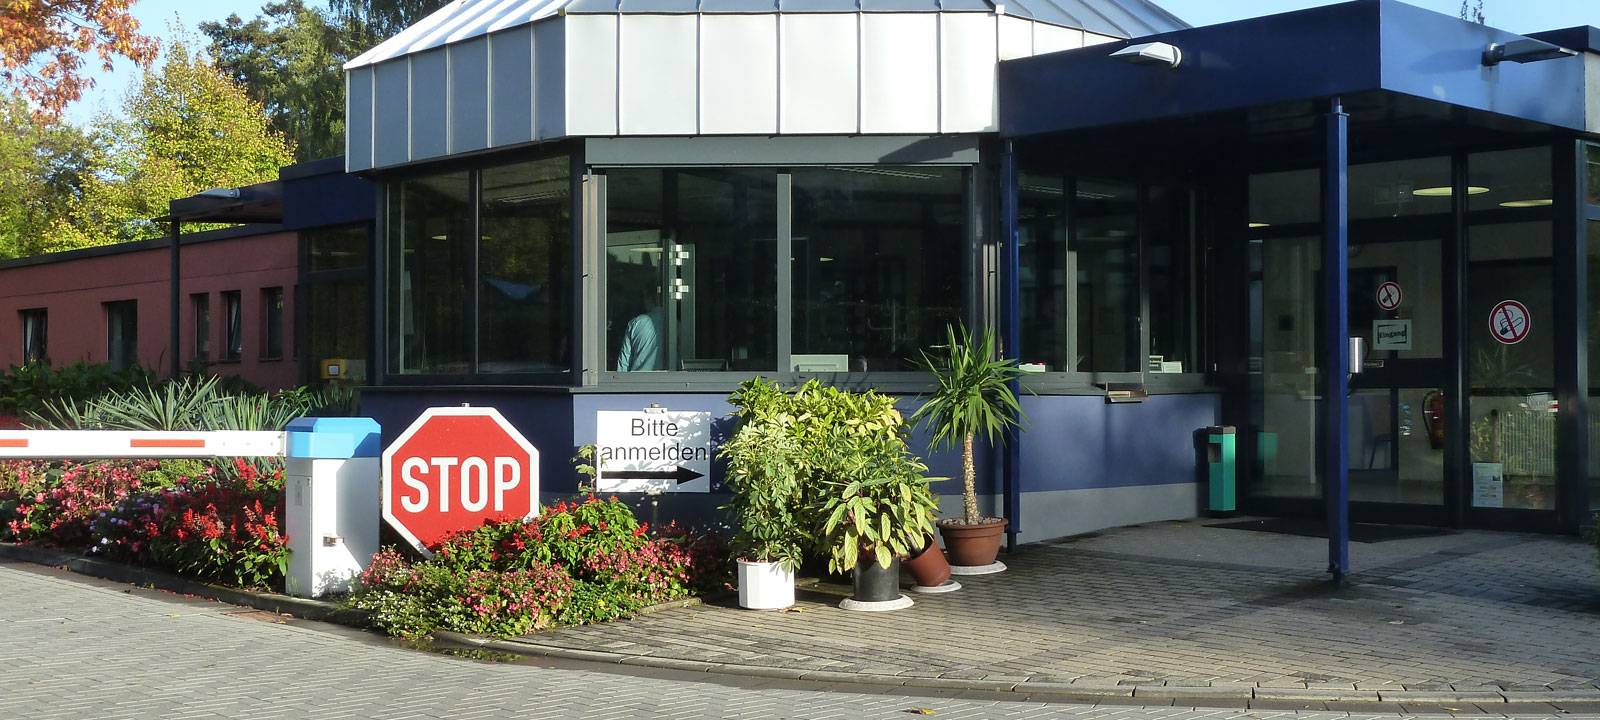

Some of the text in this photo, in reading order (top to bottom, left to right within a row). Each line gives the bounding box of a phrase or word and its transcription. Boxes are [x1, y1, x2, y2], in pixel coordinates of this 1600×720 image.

[631, 418, 678, 437] Bitte
[601, 442, 707, 461] anmelden
[400, 456, 521, 513] STOP
